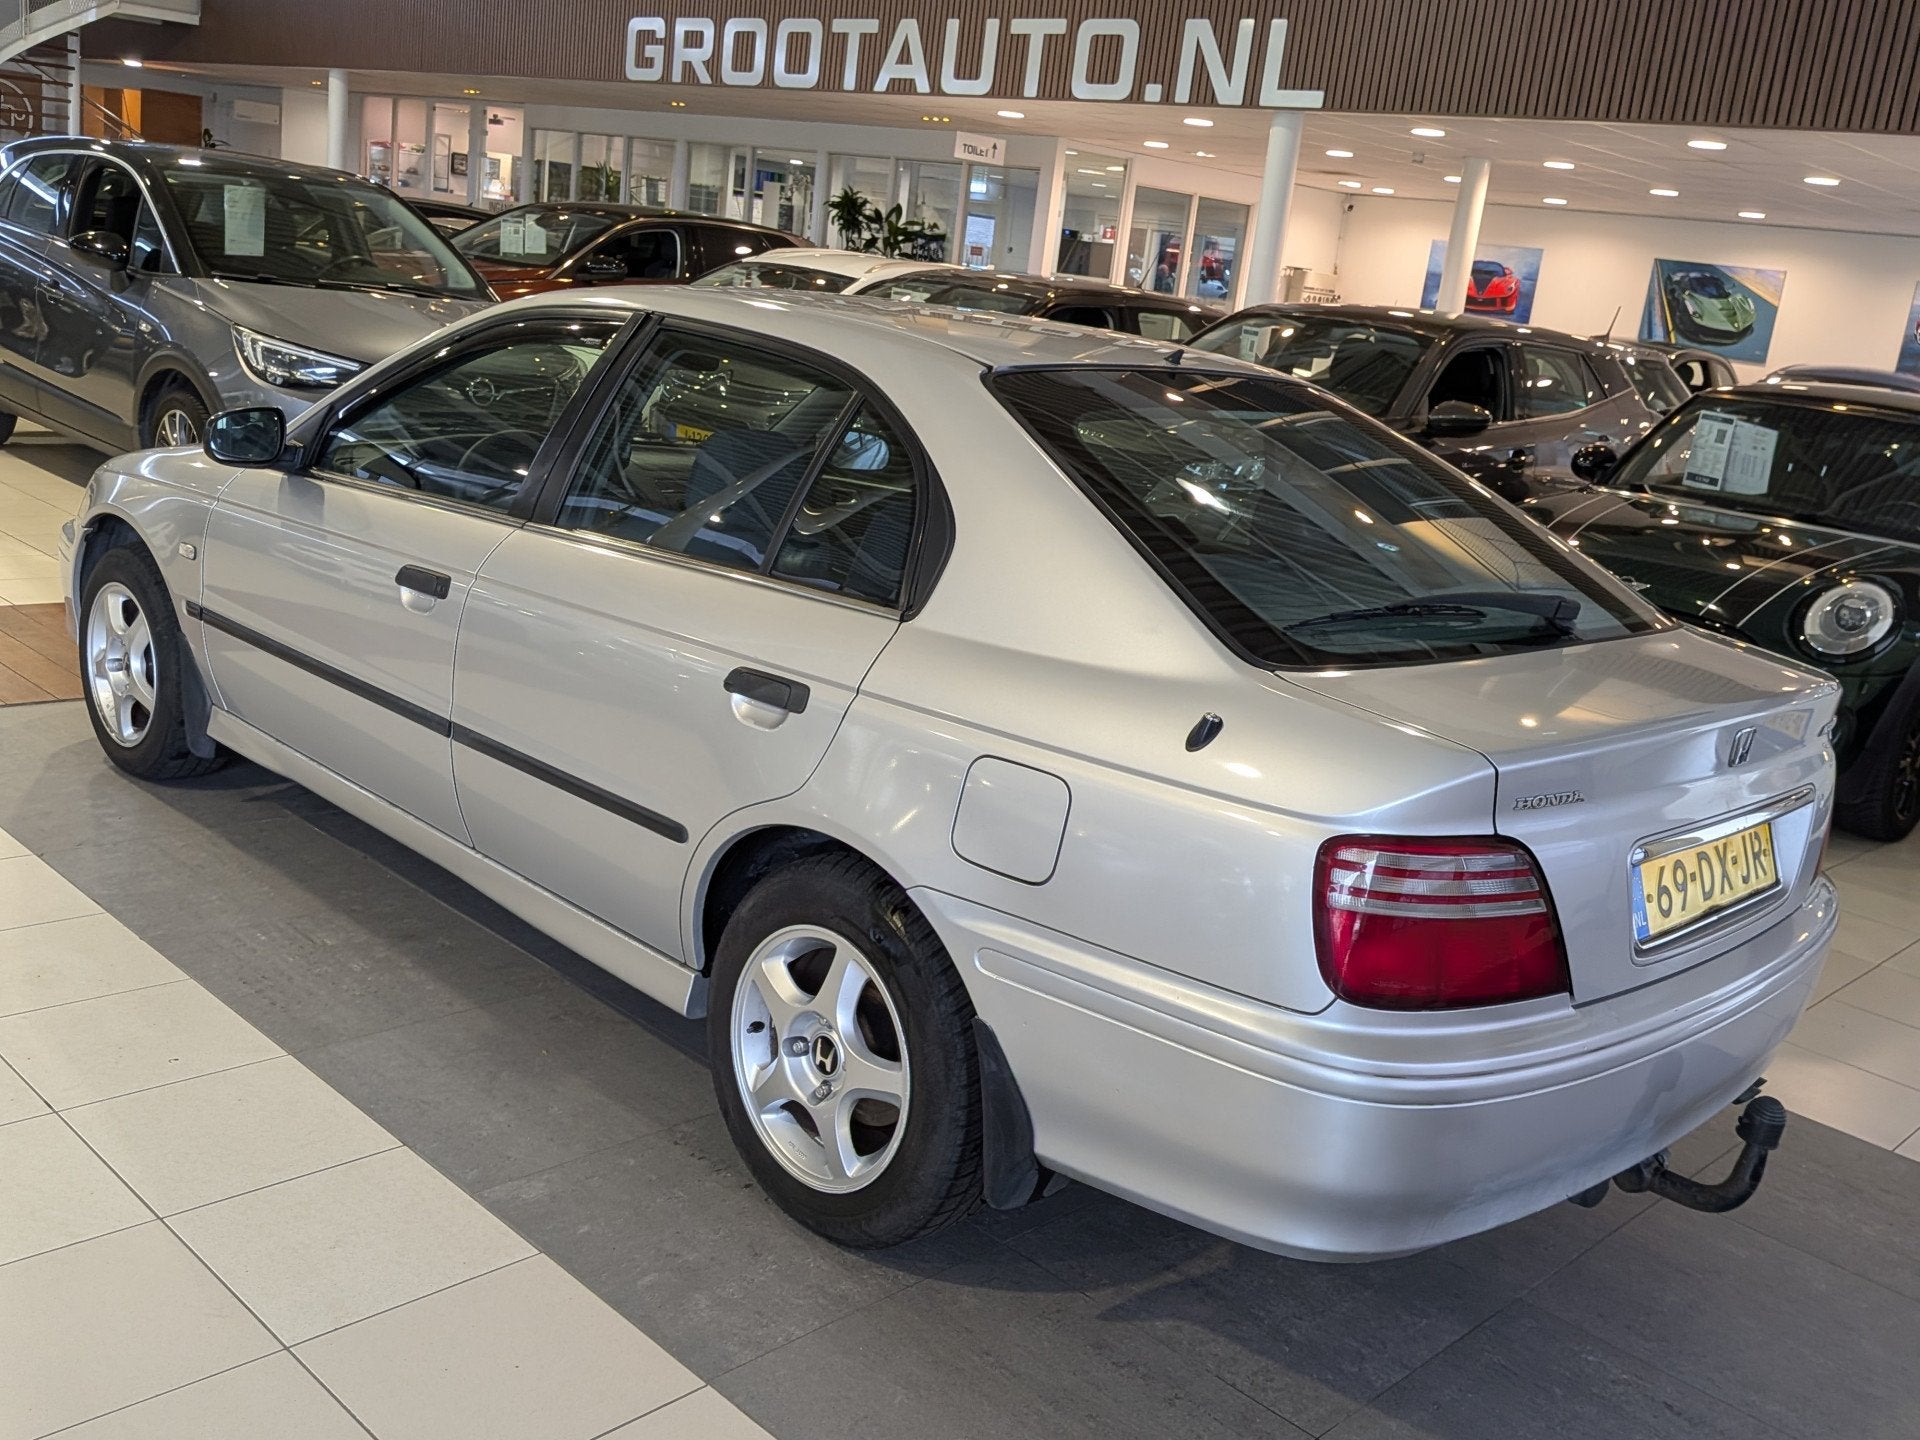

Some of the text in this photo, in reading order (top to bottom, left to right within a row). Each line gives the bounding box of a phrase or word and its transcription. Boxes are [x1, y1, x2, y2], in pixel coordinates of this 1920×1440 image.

[625, 17, 1325, 109] GROOTAUTO.NL
[963, 143, 989, 158] TOILET
[1513, 790, 1584, 810] HONDA
[1657, 830, 1767, 919] 69-DX-JR
[1633, 910, 1647, 927] NL
